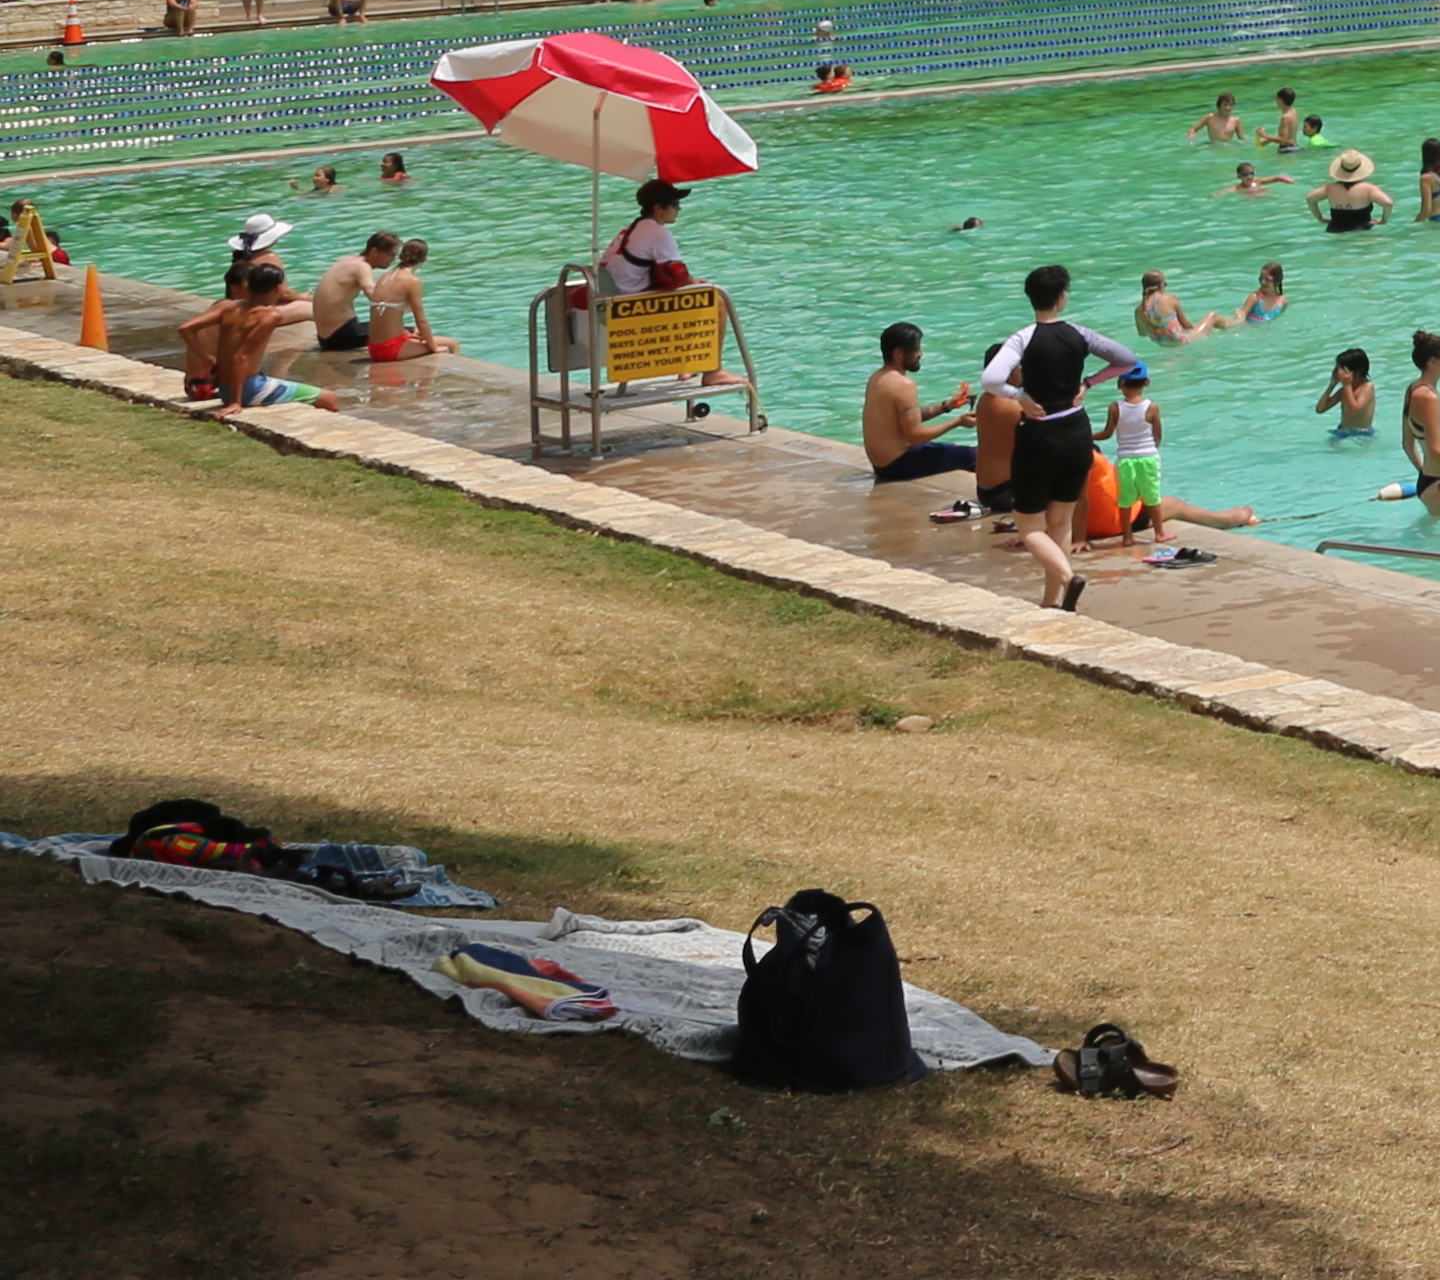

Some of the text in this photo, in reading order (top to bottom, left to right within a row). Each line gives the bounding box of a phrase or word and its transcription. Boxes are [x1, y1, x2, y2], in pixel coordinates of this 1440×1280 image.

[617, 292, 709, 316] CAUTION
[609, 328, 637, 338] POOL
[641, 324, 668, 334] DECK
[609, 330, 716, 349] WAYS CAN BE SLIPPERY
[613, 341, 712, 360] WHEN WET. PLEASE
[614, 353, 711, 372] WATCH YOUR STEP.
